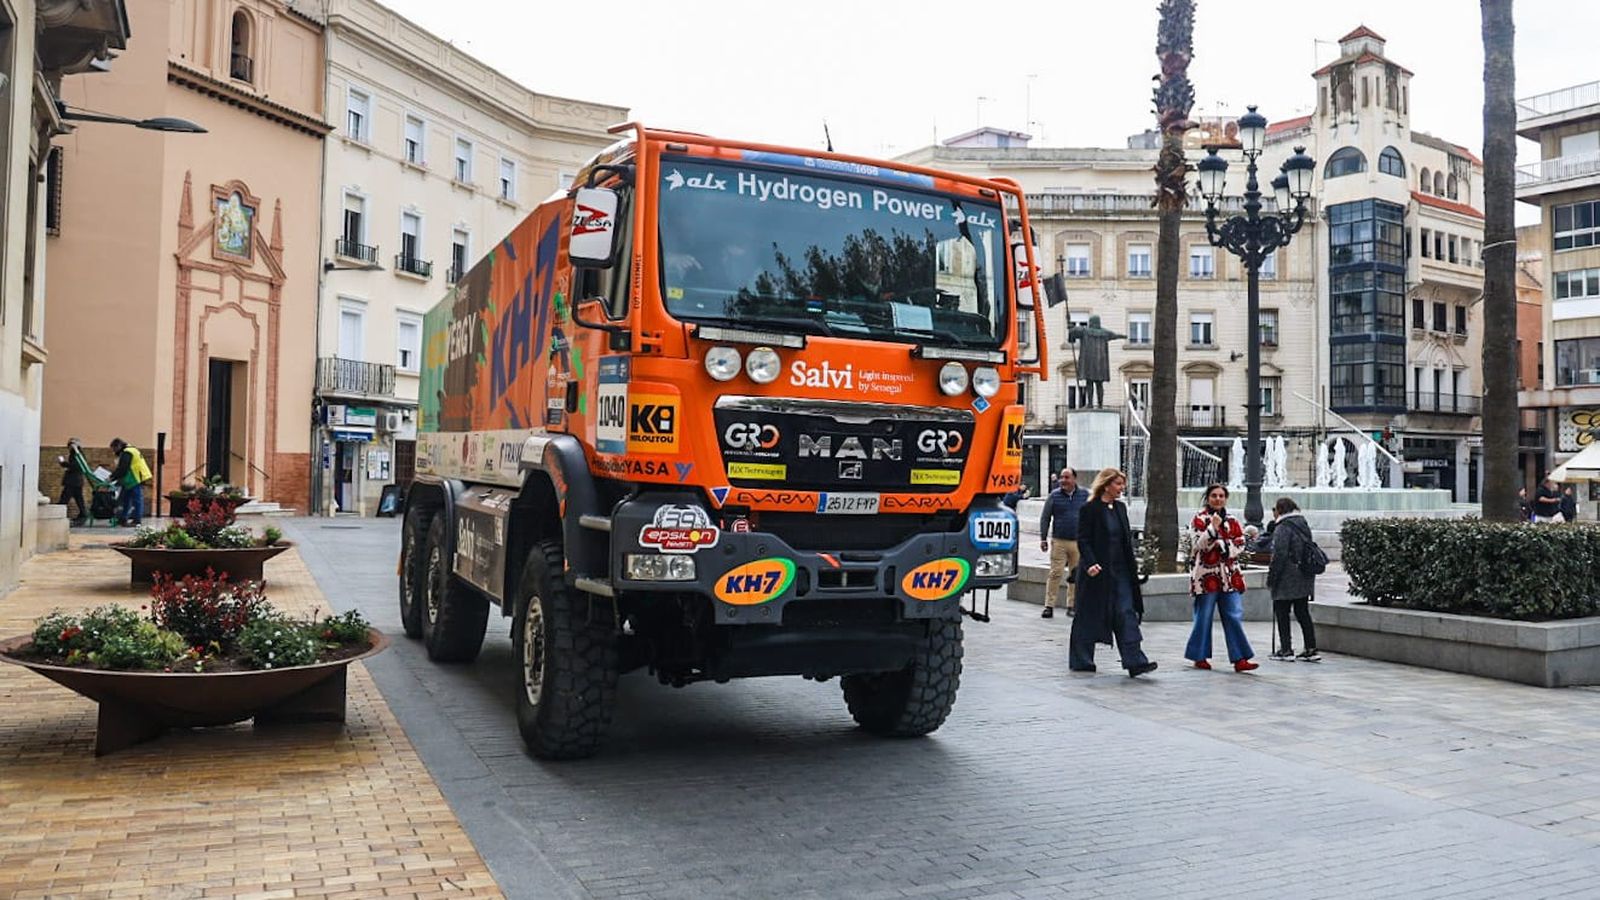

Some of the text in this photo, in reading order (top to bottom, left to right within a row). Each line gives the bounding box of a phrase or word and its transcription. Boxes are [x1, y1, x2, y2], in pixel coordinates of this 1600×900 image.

[687, 172, 728, 191] alx
[738, 172, 944, 221] Hydrogen Power
[967, 211, 997, 229] alx
[790, 360, 853, 390] Salvi
[859, 369, 881, 382] Light
[858, 381, 902, 396] by Senegal
[599, 395, 625, 428] 1040
[724, 422, 780, 448] GRO
[917, 429, 963, 454] GRO
[798, 433, 903, 461] MAN
[623, 460, 669, 476] YASA
[827, 496, 878, 510] 2512 FYP
[978, 521, 1011, 539] 1040
